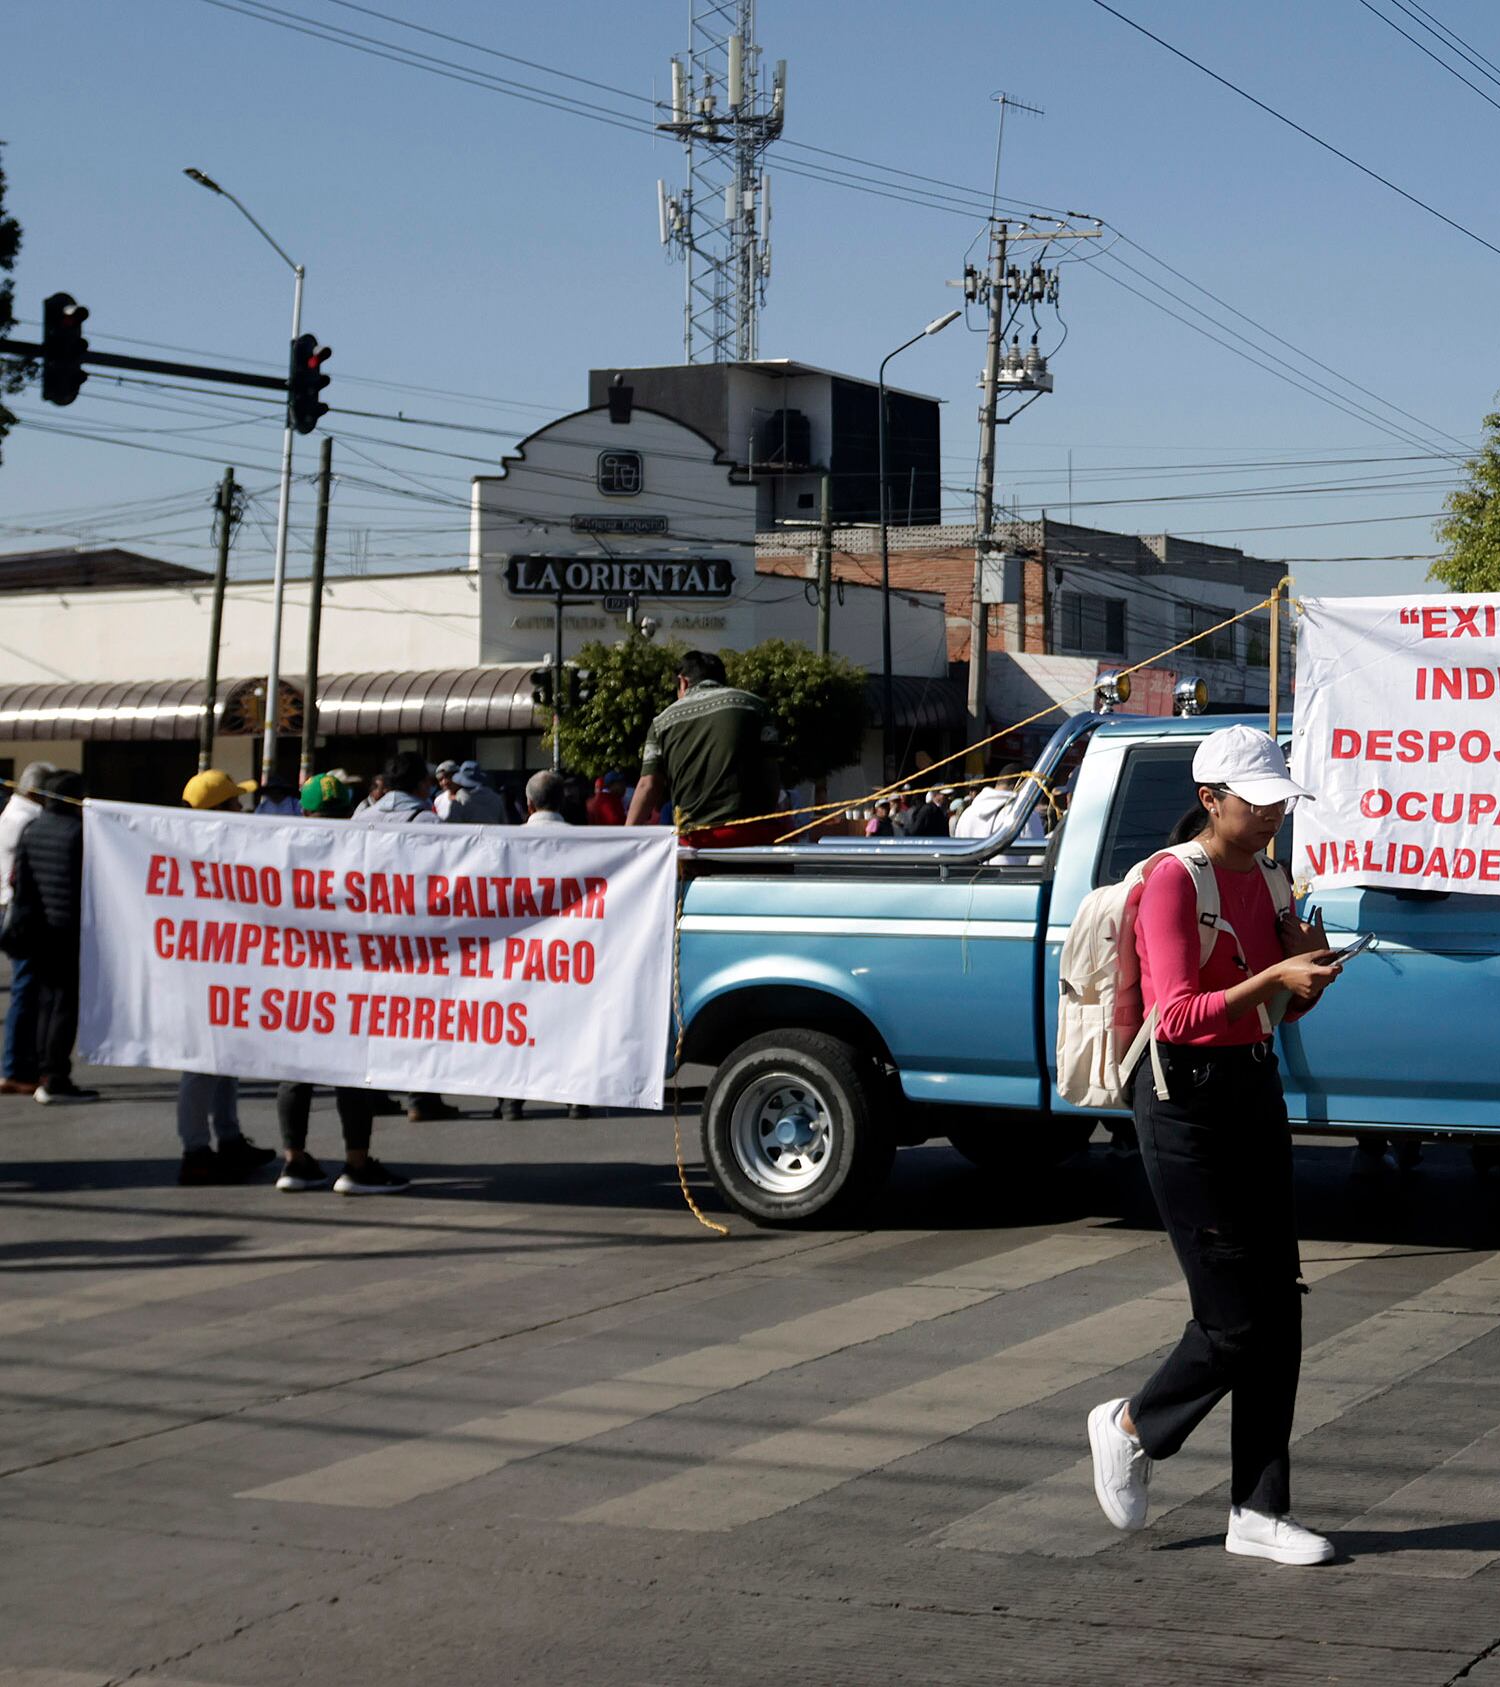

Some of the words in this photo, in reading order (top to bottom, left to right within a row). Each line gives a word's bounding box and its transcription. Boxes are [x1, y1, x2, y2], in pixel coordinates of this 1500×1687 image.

[516, 562, 561, 590] LA
[565, 563, 727, 592] ORIENTAL
[146, 855, 184, 897] EL
[193, 860, 283, 908] EJIDO
[292, 868, 335, 912] DE
[345, 871, 416, 916] SAN
[427, 874, 609, 920] BALTAZAR
[154, 917, 353, 971] CAMPECHE
[358, 933, 450, 977] EXIJE
[460, 937, 494, 979] EL
[503, 937, 596, 986] PAGO
[208, 984, 250, 1028] DE
[259, 988, 337, 1036] SUS
[347, 993, 537, 1047] TERRENOS.
